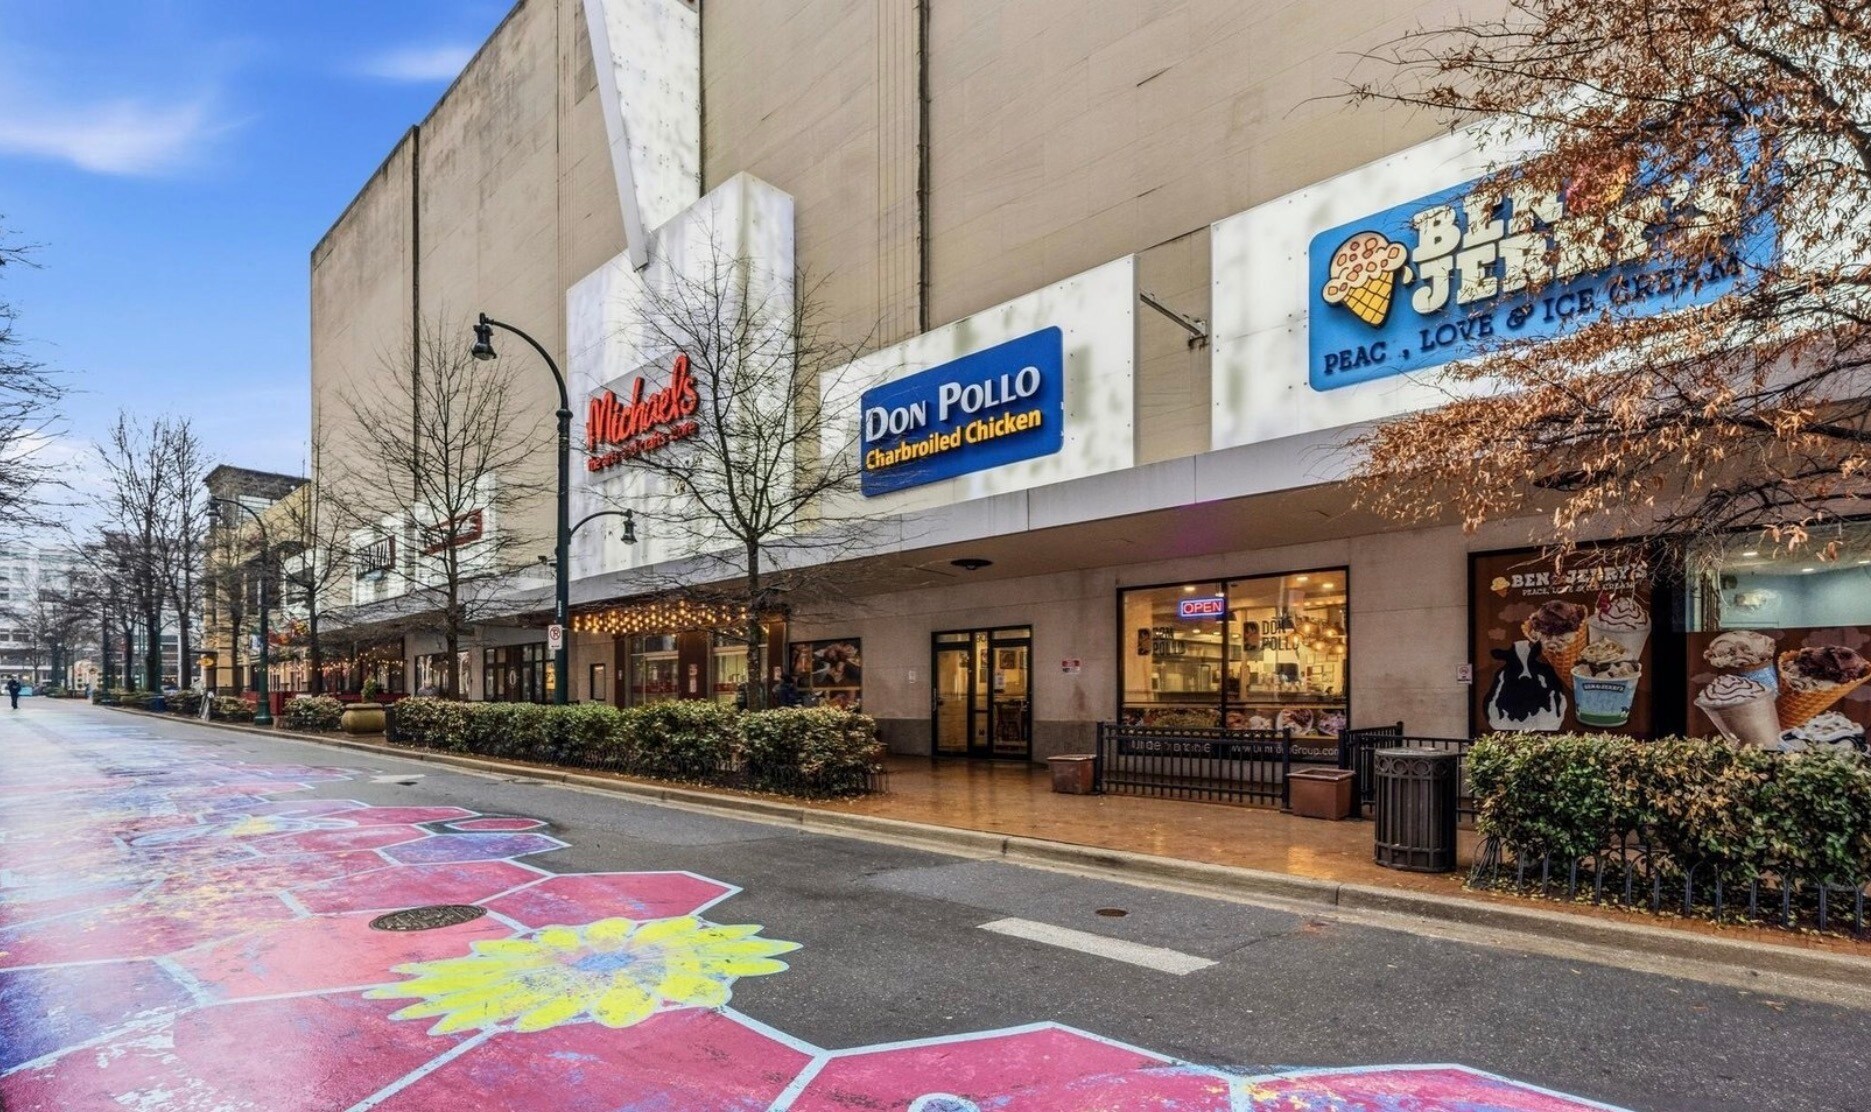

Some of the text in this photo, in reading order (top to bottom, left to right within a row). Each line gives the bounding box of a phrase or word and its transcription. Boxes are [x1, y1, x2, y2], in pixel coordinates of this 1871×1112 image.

[1411, 182, 1564, 263] BEN
[1420, 313, 1494, 352] LOVE
[1506, 302, 1535, 330] &
[1543, 287, 1595, 323] ICE
[586, 354, 699, 452] Michaels
[866, 366, 1042, 443] DON POLLO
[866, 409, 1043, 471] Charbroiled Chicken
[1183, 601, 1223, 615] OPEN
[1511, 572, 1550, 588] BEN
